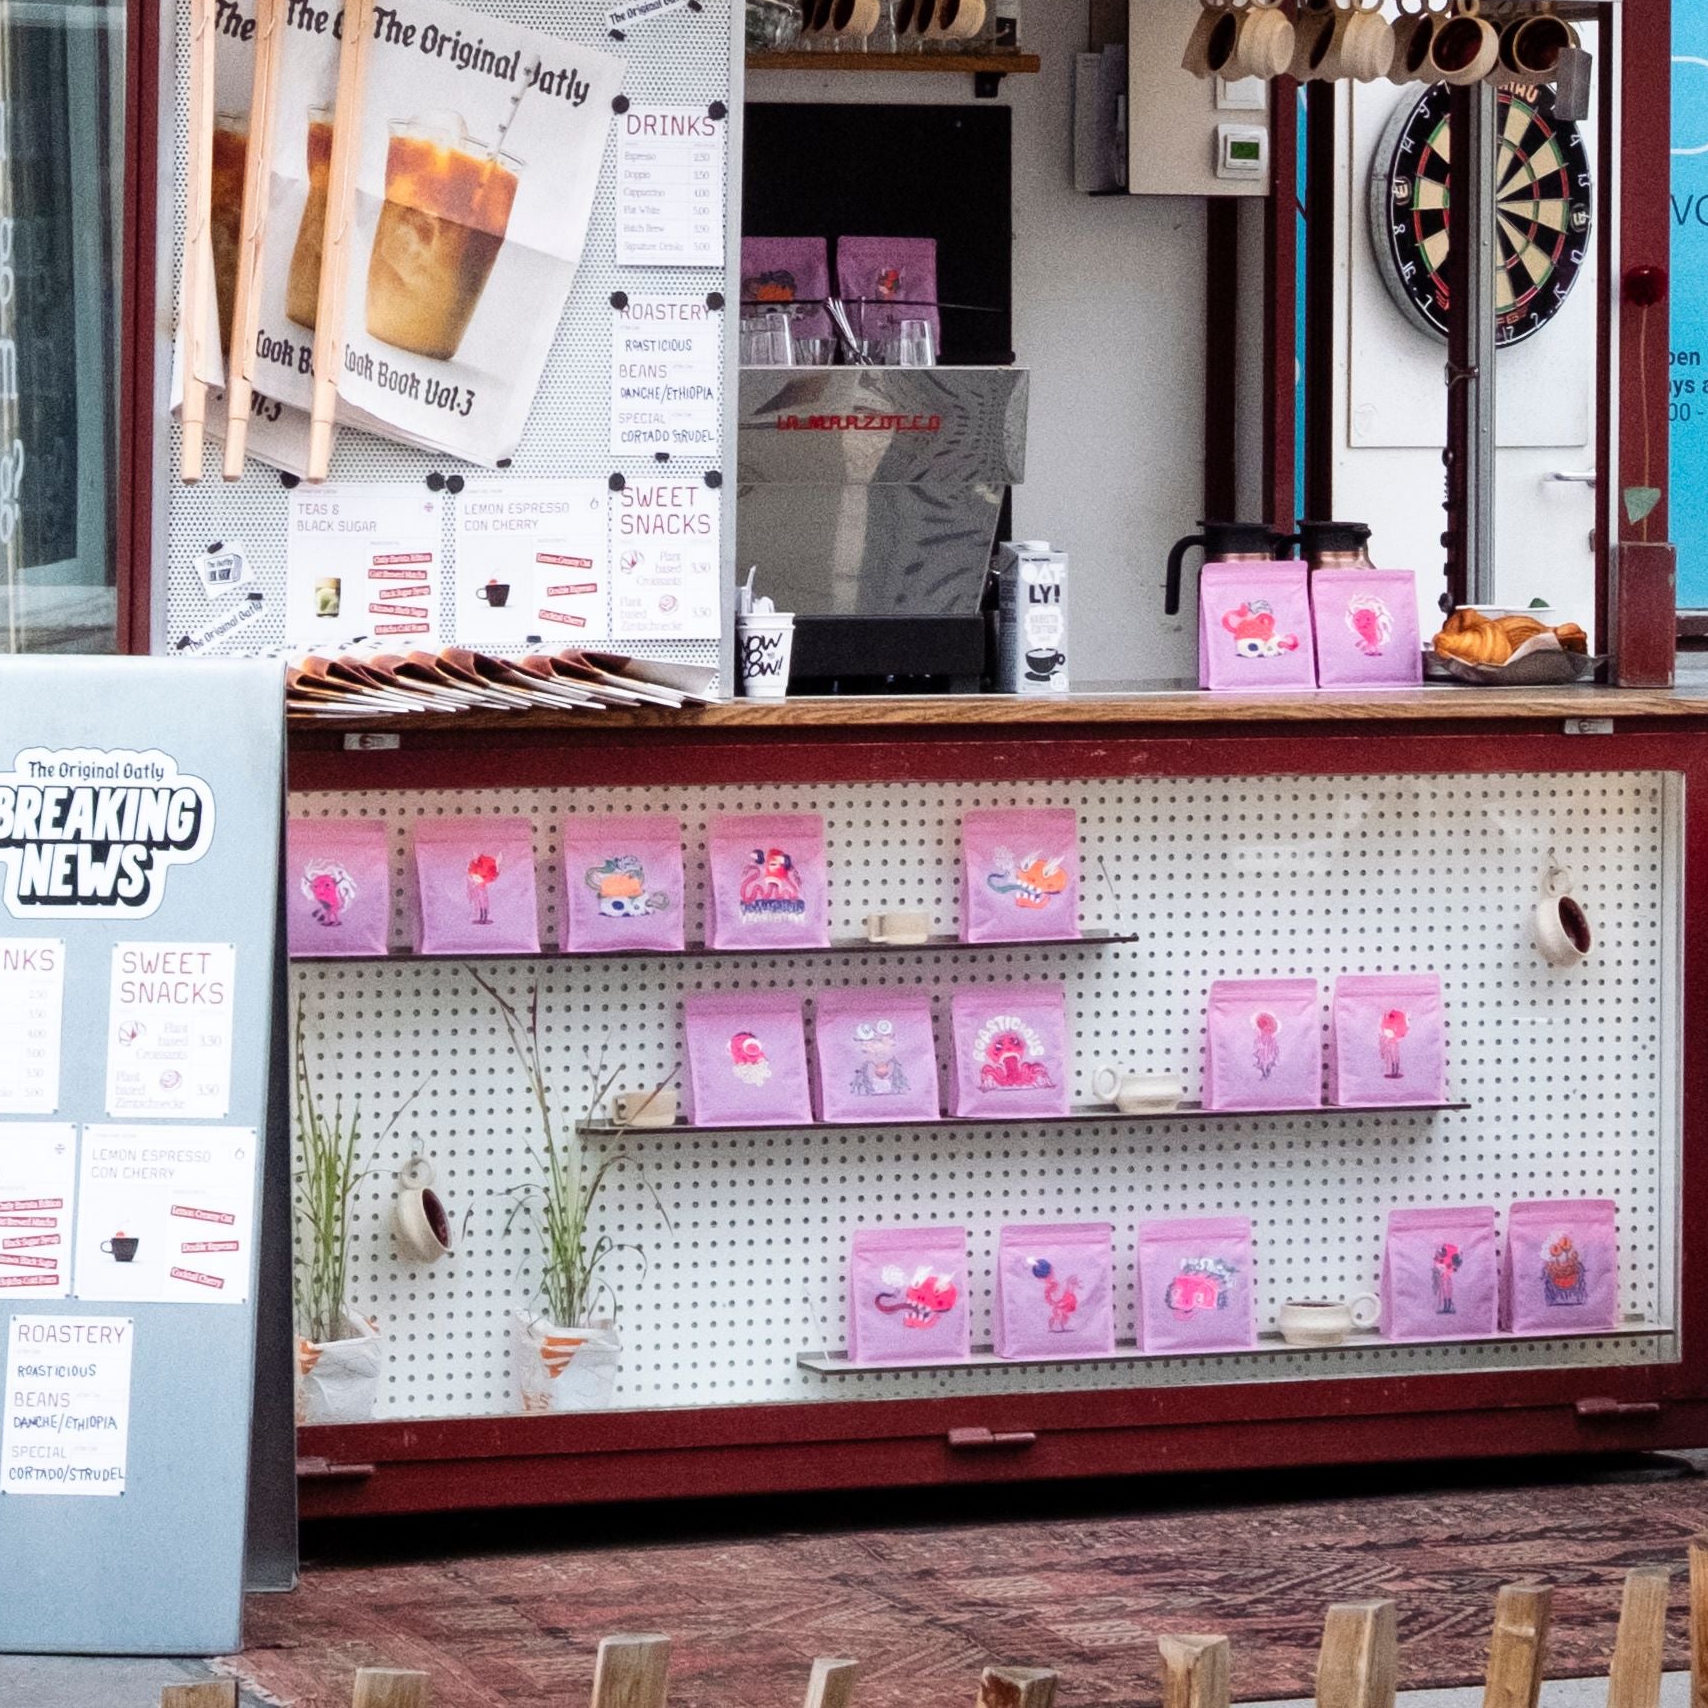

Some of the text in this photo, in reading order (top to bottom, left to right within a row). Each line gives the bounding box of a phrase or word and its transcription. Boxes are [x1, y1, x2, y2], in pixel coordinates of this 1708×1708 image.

[372, 5, 414, 47] The
[419, 24, 520, 82] Original
[626, 114, 716, 136] DRINKS
[619, 303, 710, 320] ROASTERY
[625, 339, 692, 352] ROASTICIOUS
[619, 364, 668, 378] BEANS
[377, 361, 420, 401] Book
[619, 412, 666, 424] SPECIAL
[621, 486, 699, 508] SWEET
[297, 503, 328, 515] TEAS
[464, 502, 570, 515] LEMON ESPRESSO
[297, 520, 377, 532] BLACK SUGAR
[464, 519, 539, 532] CON CHERRY
[620, 513, 711, 535] SNACKS
[1029, 584, 1061, 605] LY!
[28, 761, 164, 782] The Original Oatly
[17, 843, 151, 904] NEWS
[122, 951, 212, 974] SWEET
[120, 981, 224, 1004] SNACKS
[92, 1148, 211, 1163] LEMON ESPRESSO
[91, 1166, 175, 1180] CON CHERRY
[17, 1324, 125, 1344] ROASTERY
[17, 1363, 97, 1378] ROASTICIOUS
[13, 1391, 71, 1408] BEANS
[11, 1445, 67, 1459] SPECIAL
[9, 1464, 124, 1483] CORTADO/STRUDEL
